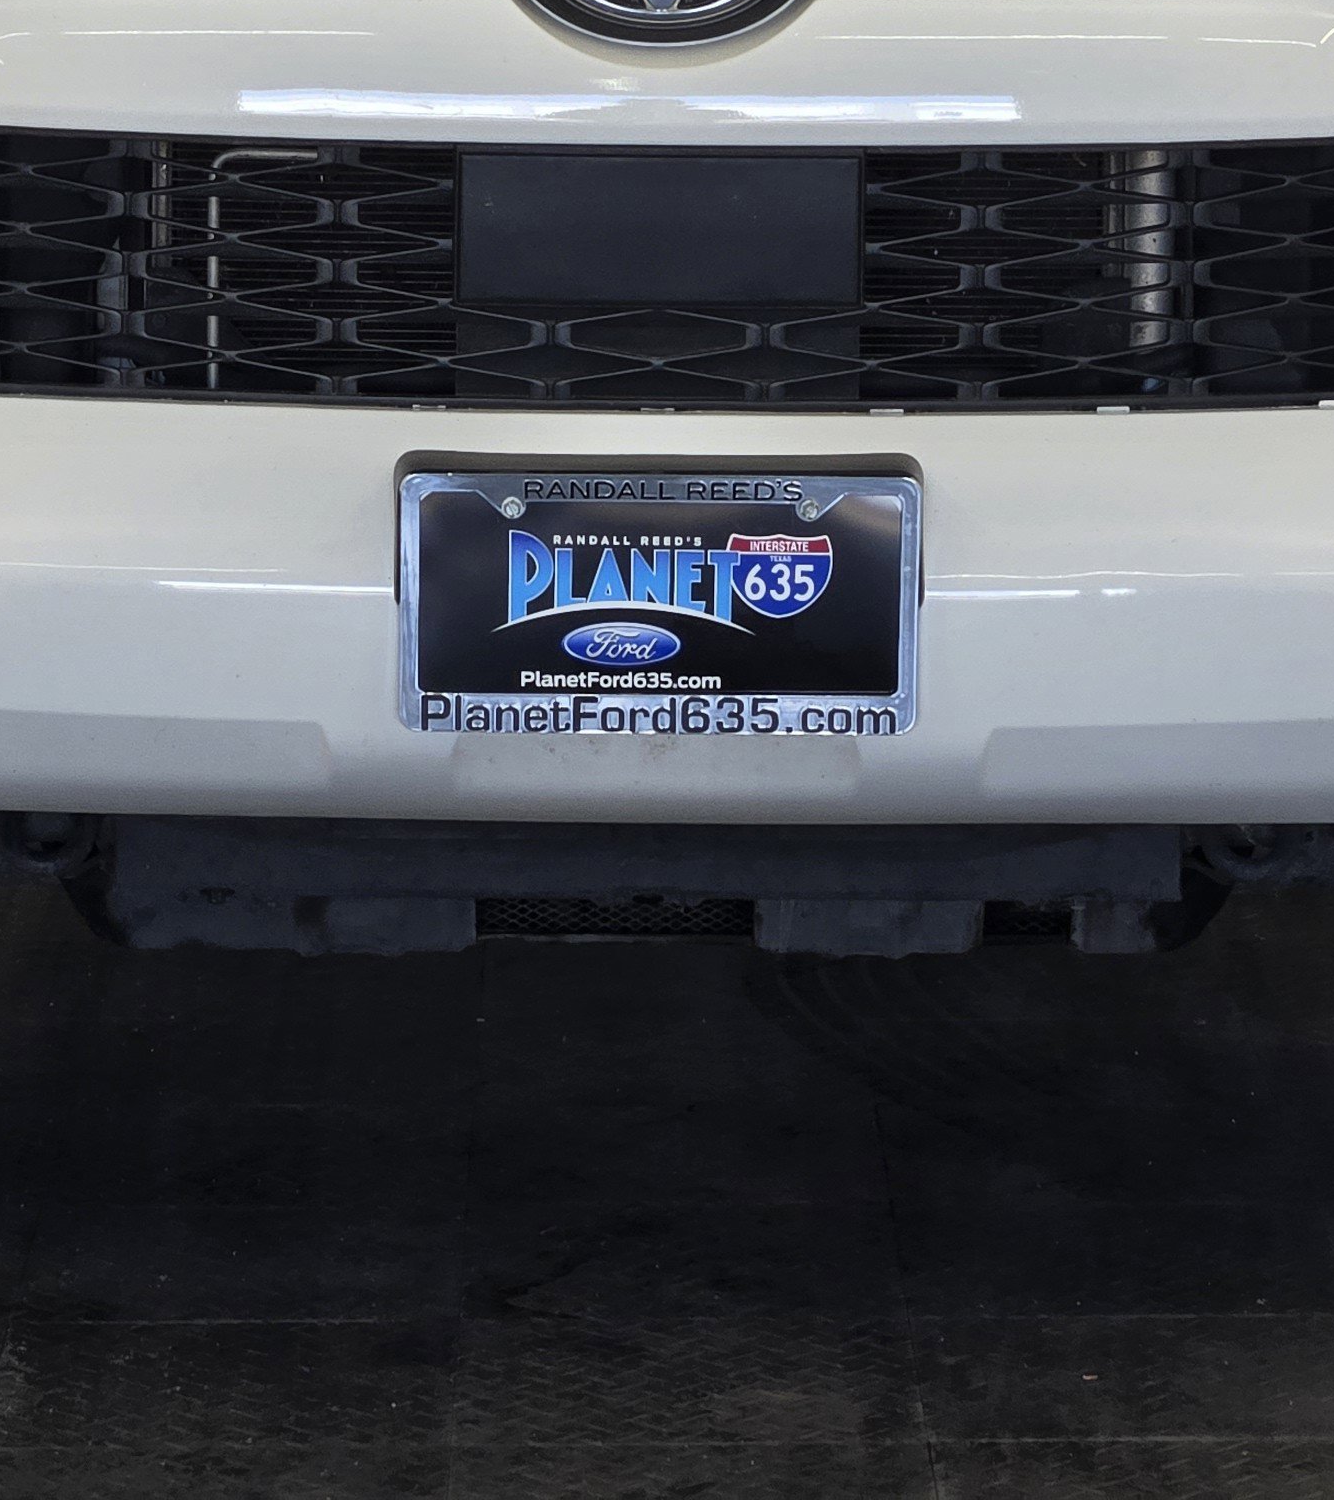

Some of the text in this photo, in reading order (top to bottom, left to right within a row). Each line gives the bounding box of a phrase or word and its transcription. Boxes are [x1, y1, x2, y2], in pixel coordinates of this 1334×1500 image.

[524, 479, 803, 501] RANDALL REED'S
[553, 535, 702, 547] RANDALL REED'S
[750, 540, 809, 552] INTERSTATE
[508, 529, 741, 624] PLANET
[744, 563, 814, 601] 635
[585, 627, 657, 660] Ford
[520, 670, 722, 689] PlanetFord635.com
[420, 694, 897, 734] PlanetFord635.com
